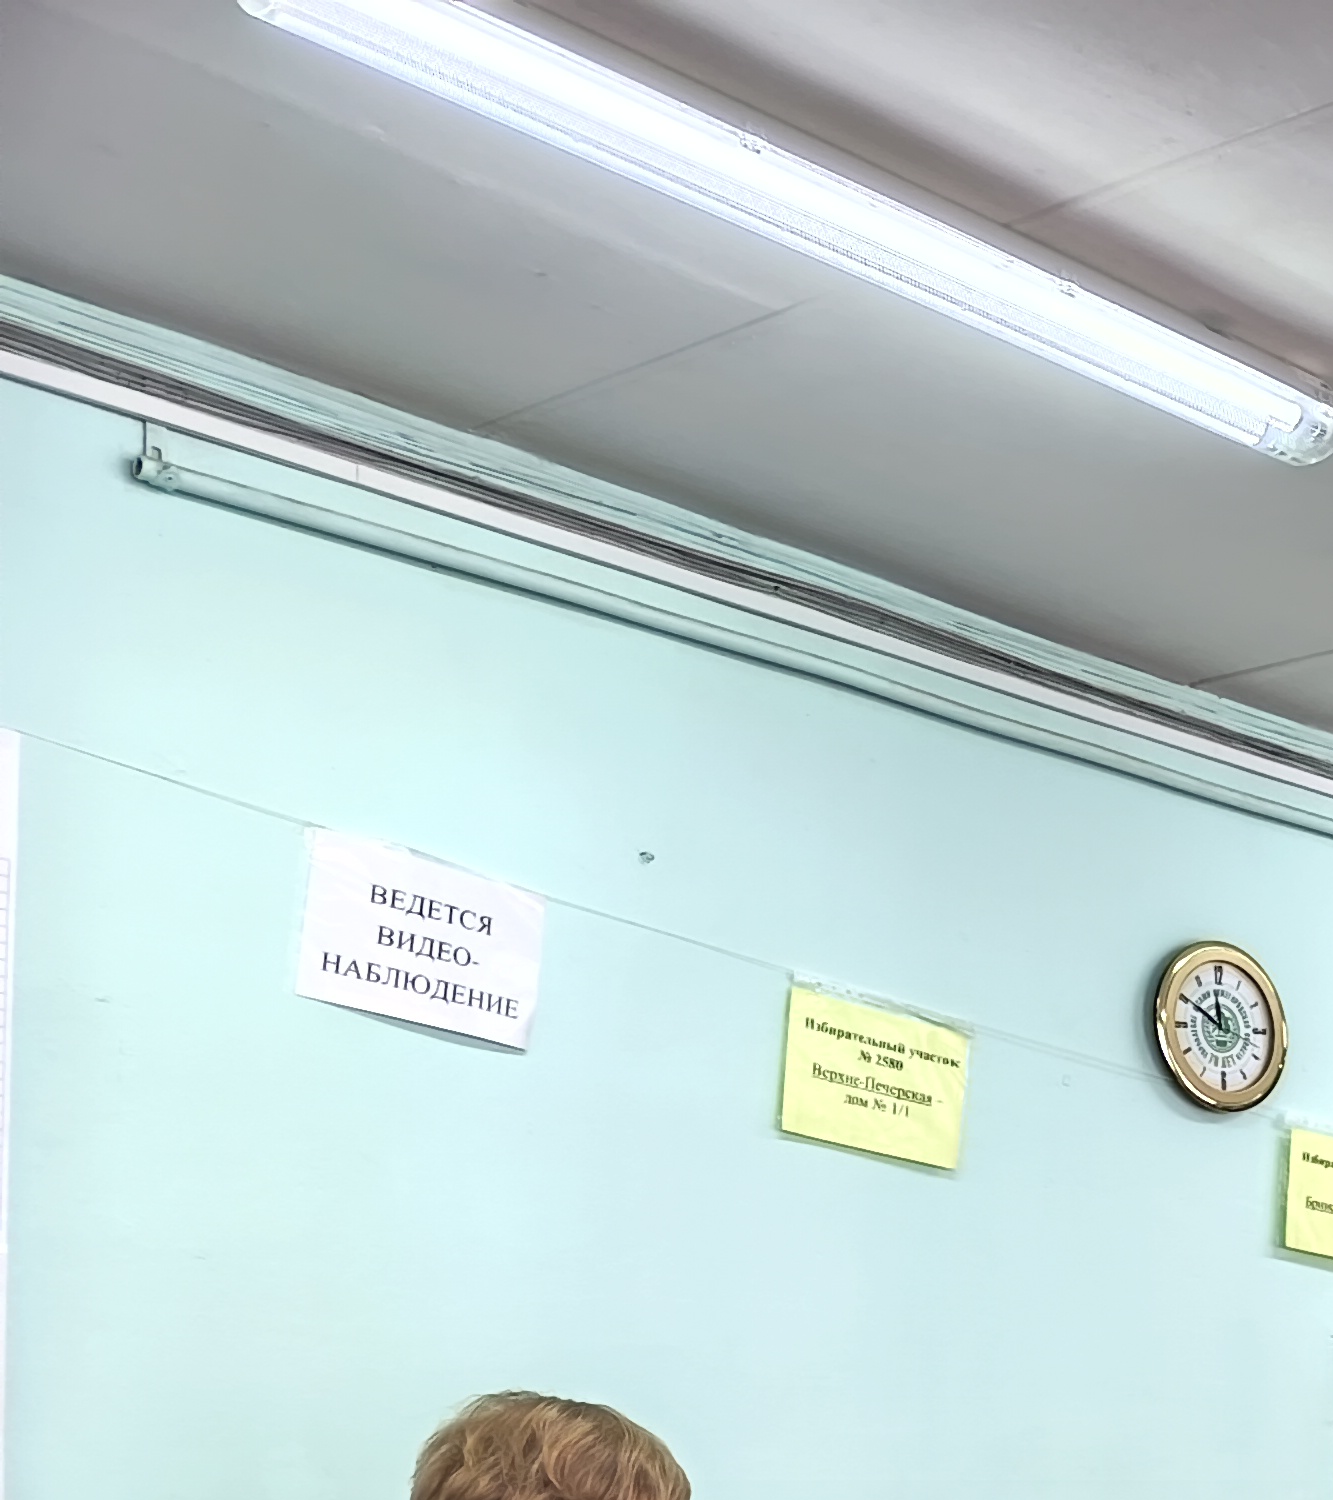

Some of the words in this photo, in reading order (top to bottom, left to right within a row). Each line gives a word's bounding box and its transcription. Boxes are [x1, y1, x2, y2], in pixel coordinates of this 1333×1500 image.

[370, 884, 493, 936] ВЕДЕТСЯ
[377, 925, 480, 967] ВИДЕО-
[321, 951, 519, 1019] НАБЛЮДЕНИЕ
[805, 1016, 905, 1054] Избирательный
[909, 1047, 961, 1068] участок
[857, 1049, 872, 1063] №
[812, 1062, 933, 1105] Верхне-Печерская
[844, 1094, 868, 1108] дом
[872, 1097, 886, 1112] №
[892, 1102, 909, 1117] 1/1
